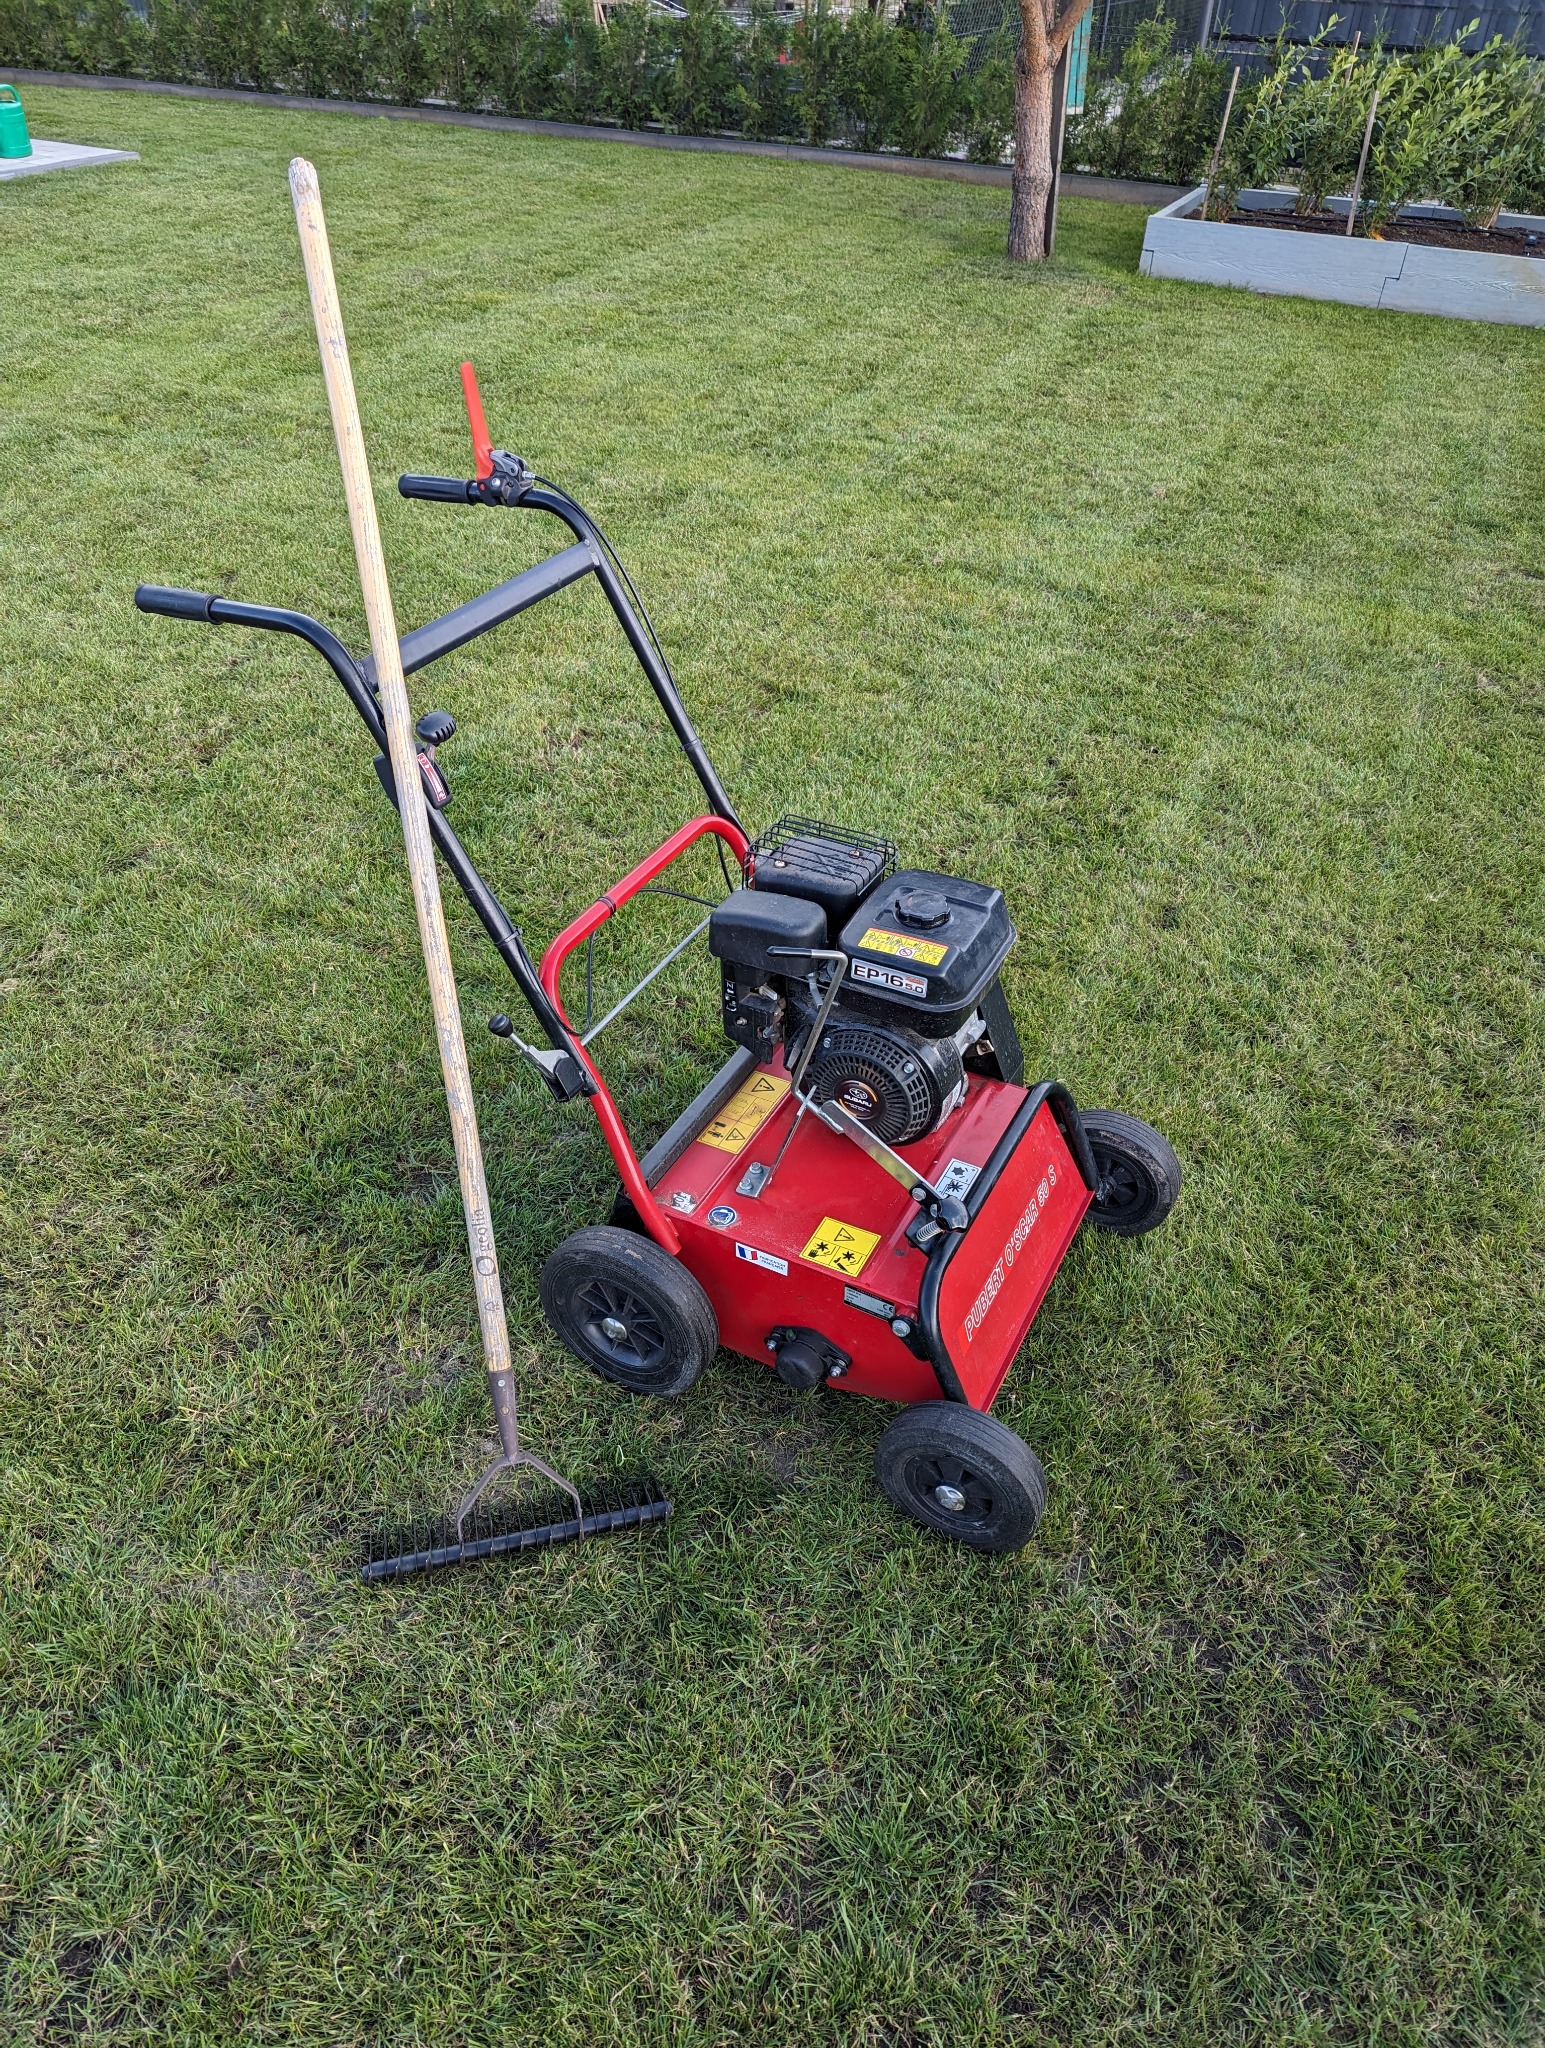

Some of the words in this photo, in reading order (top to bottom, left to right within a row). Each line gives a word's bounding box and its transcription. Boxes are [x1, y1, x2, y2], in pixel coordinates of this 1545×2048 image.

[853, 964, 904, 987] EP16
[905, 983, 924, 994] 5.0
[843, 1094, 873, 1108] SUBARU
[471, 1208, 494, 1251] geolia
[964, 1257, 1005, 1342] PUBERT
[1004, 1198, 1039, 1267] O'SCAR
[1048, 1165, 1057, 1186] S
